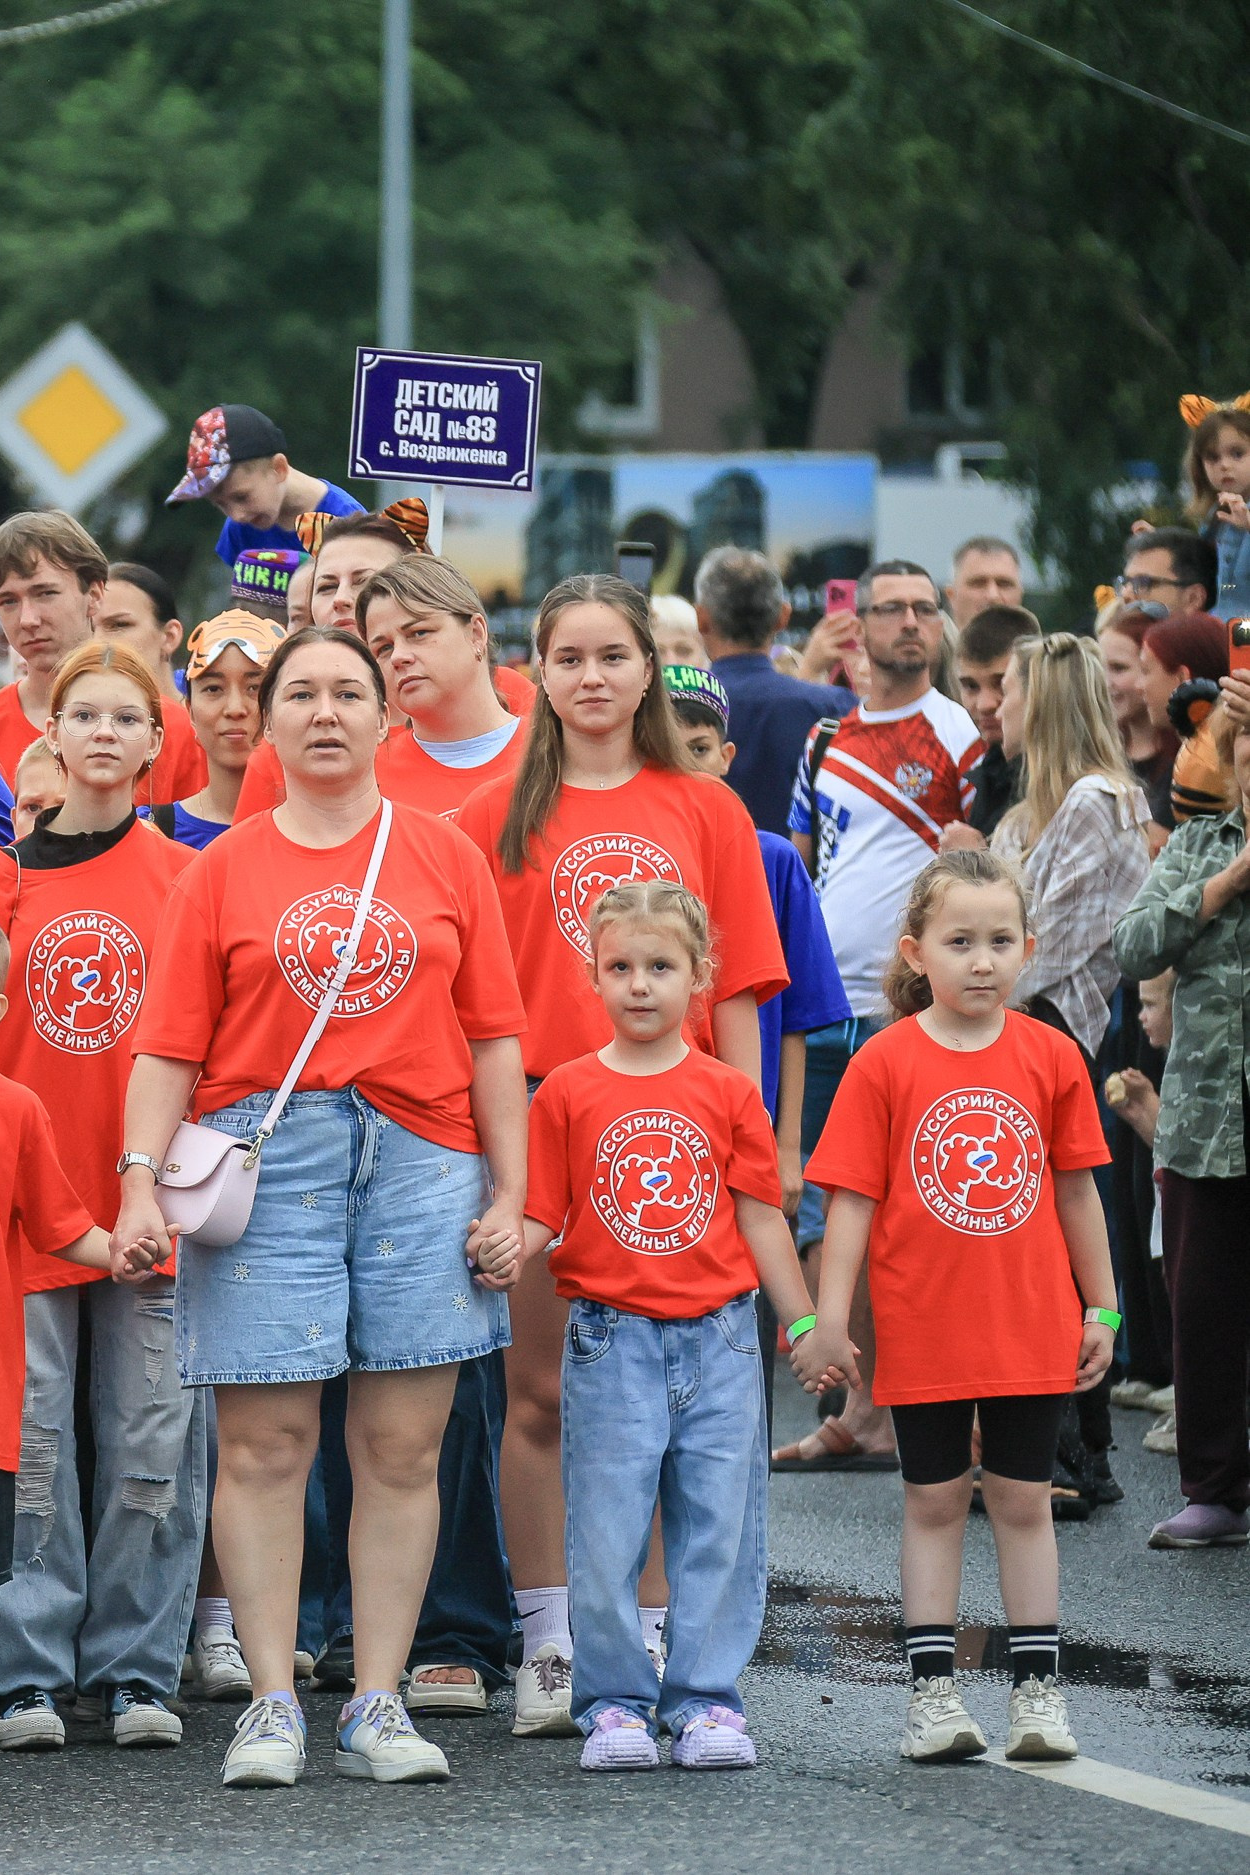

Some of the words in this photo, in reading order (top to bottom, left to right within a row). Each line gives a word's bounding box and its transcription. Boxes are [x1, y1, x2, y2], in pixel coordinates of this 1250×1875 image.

[395, 378, 499, 412] ДЕТСКИЙ
[393, 409, 441, 442] САД
[446, 415, 497, 443] №83
[379, 440, 395, 456] с.
[398, 439, 508, 466] Воздвиженка
[558, 836, 673, 878] УССУРИЙСКИЕ
[32, 913, 137, 971] УССУРИЙСКИЕ
[375, 949, 411, 1000] ИГРЫ
[35, 1000, 112, 1049] СЕМЕЙНЫЕ
[112, 986, 140, 1034] ИГРЫ
[598, 1113, 709, 1164] УССУРИЙСКИЕ
[920, 1092, 1035, 1143] УССУРИЙСКИЕ
[597, 1194, 682, 1250] СЕМЕЙНЫЕ
[684, 1191, 713, 1239] ИГРЫ
[920, 1174, 1008, 1231] СЕМЕЙНЫЕ
[1010, 1171, 1038, 1220] ИГРЫ
